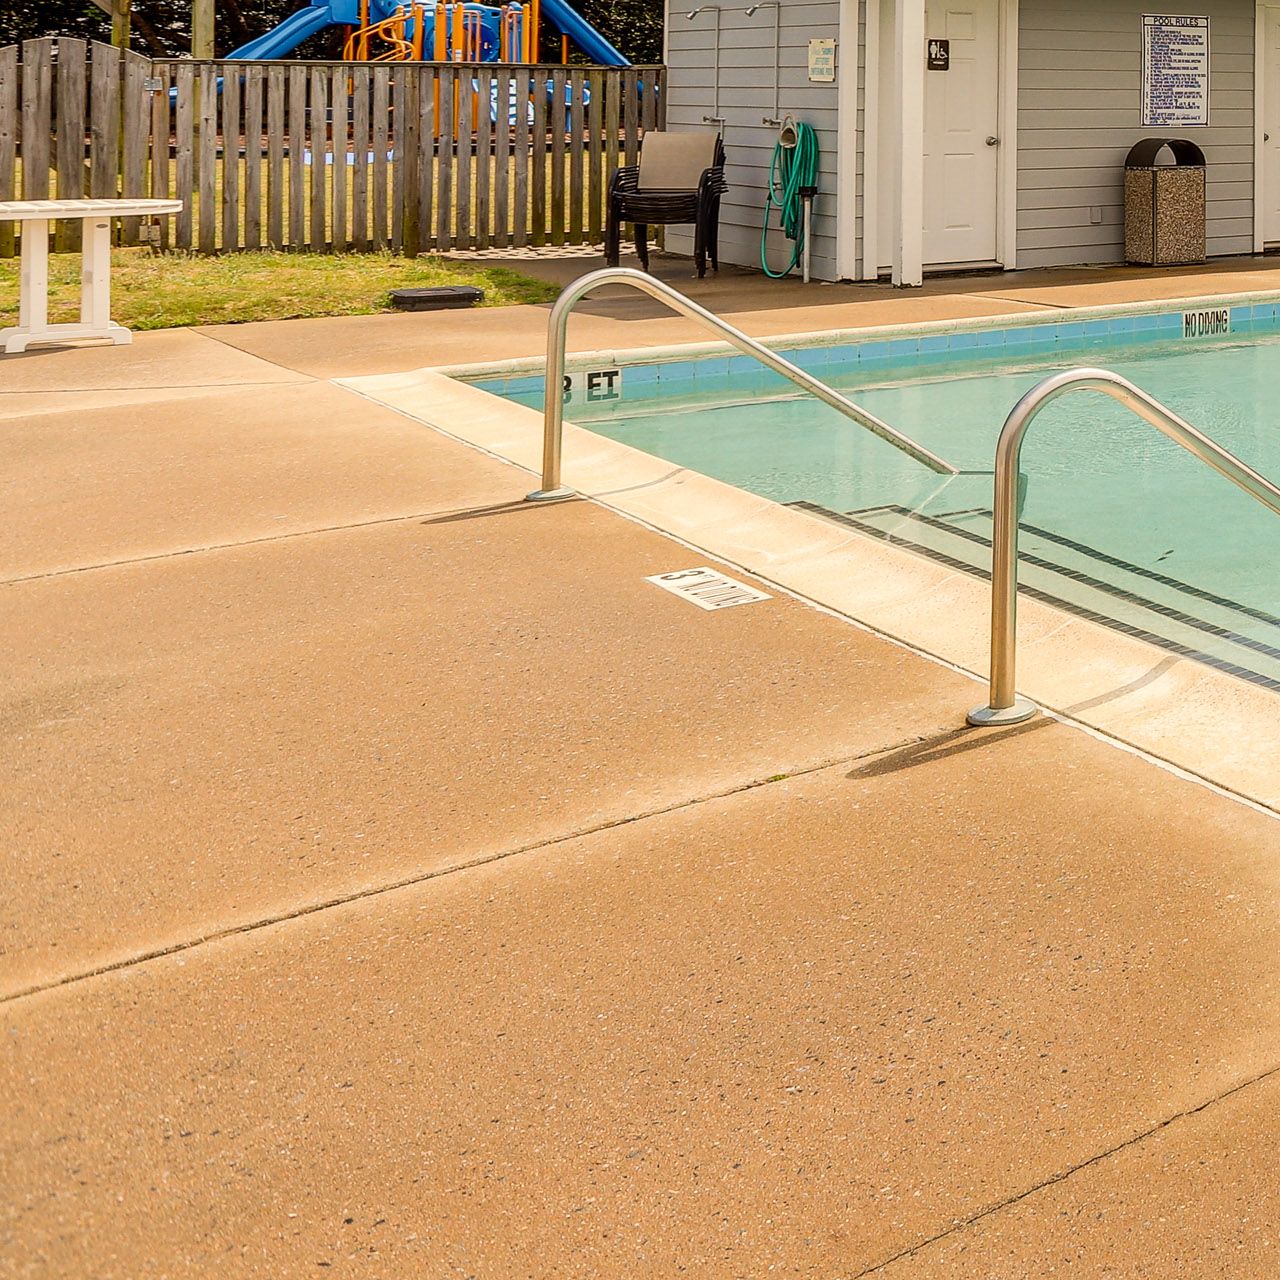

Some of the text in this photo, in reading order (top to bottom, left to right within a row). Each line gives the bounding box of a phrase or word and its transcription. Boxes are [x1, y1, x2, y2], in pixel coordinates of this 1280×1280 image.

[1154, 17, 1199, 27] POOL RULES
[1185, 310, 1228, 334] NO DIVING
[660, 570, 705, 581] 3
